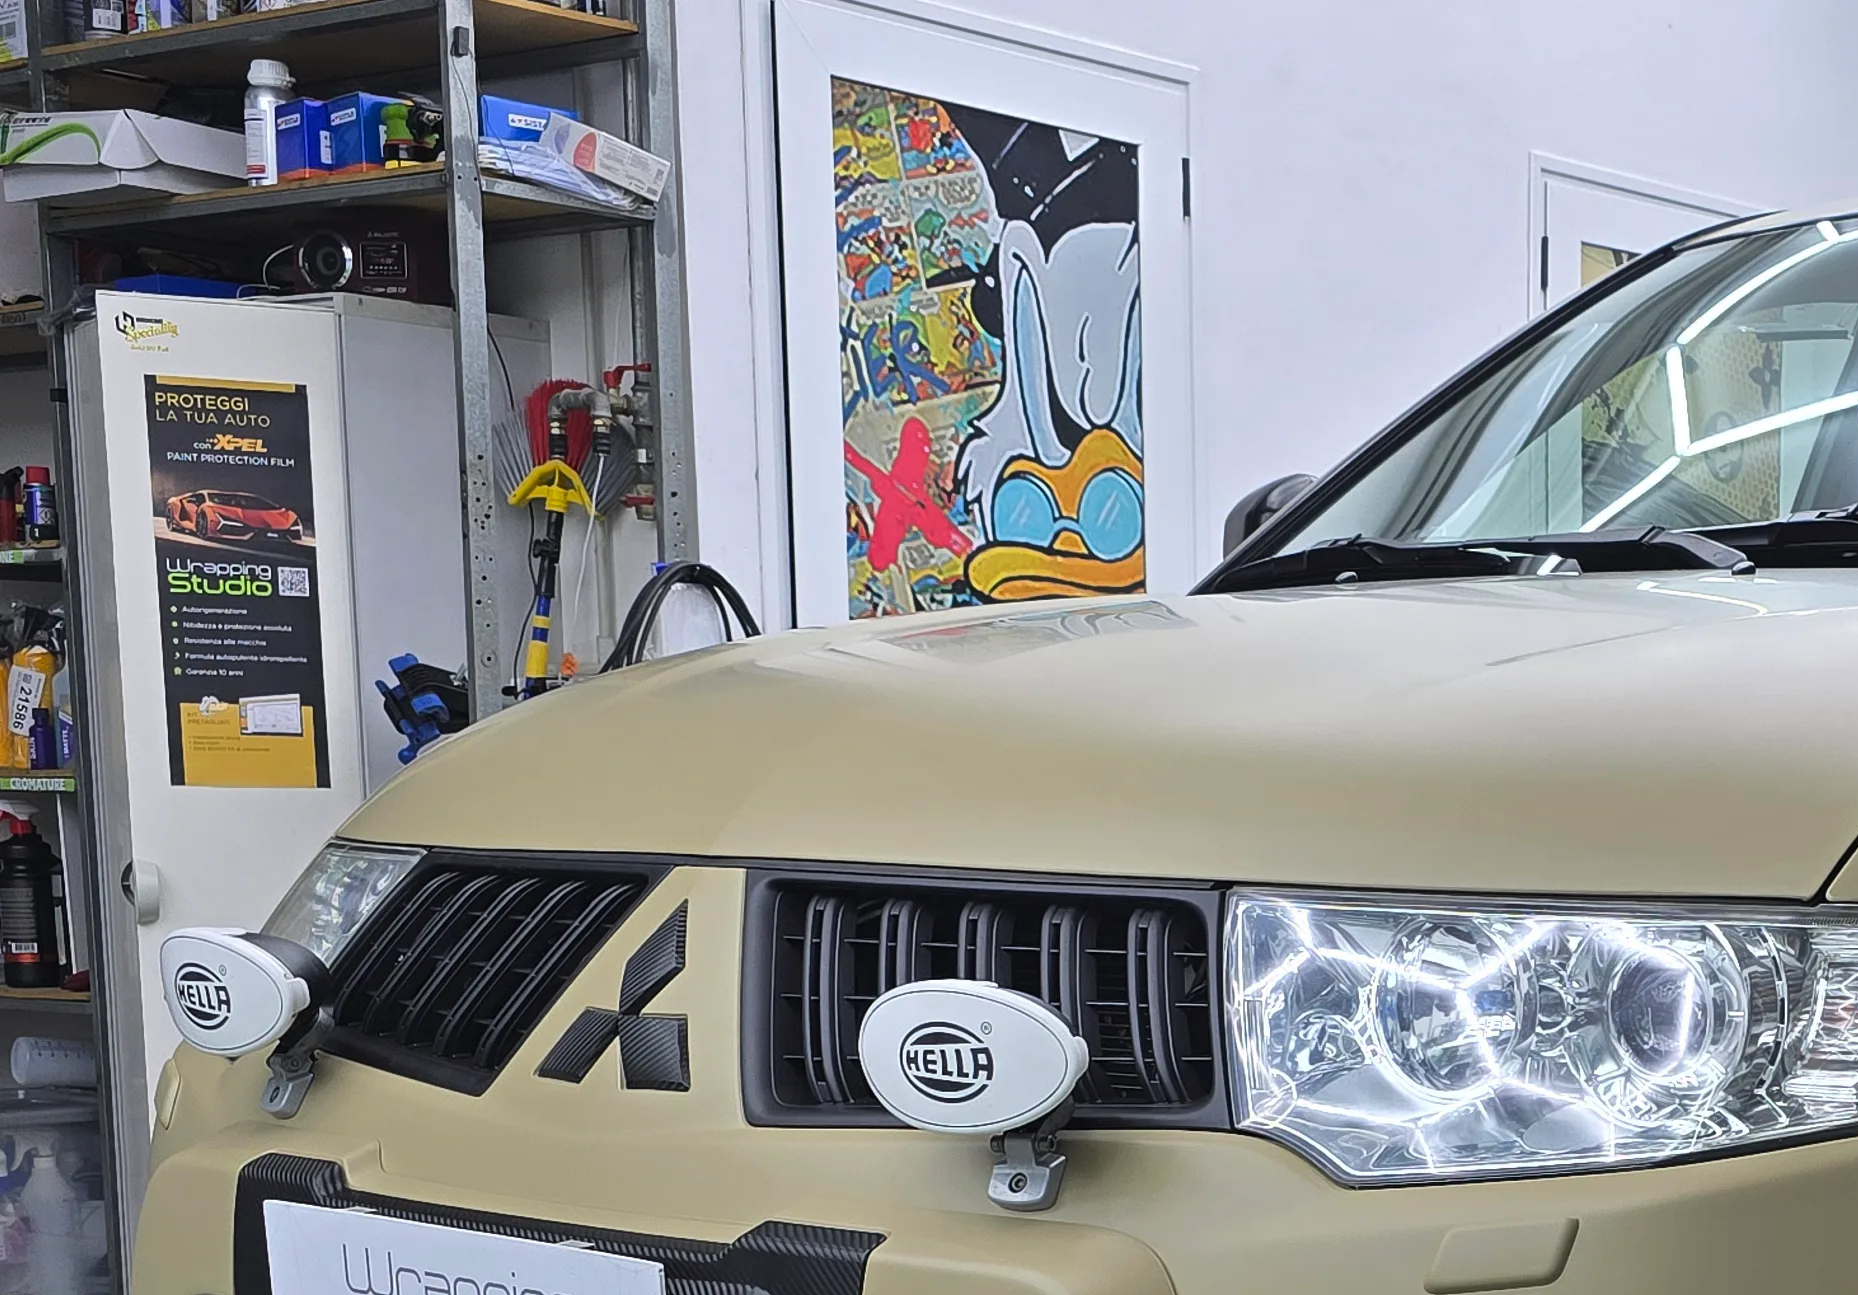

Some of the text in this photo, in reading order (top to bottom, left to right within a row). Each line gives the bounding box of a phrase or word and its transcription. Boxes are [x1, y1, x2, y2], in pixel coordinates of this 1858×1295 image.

[154, 392, 249, 412] PROTEGGI
[155, 409, 271, 428] LA TUA AUTO
[193, 433, 268, 453] con XPEL
[167, 451, 295, 468] PAINT PROTECTION FILM
[166, 557, 272, 581] Wrapping
[167, 572, 273, 597] Studio
[12, 685, 33, 731] 21586
[9, 777, 66, 791] CROMATURE
[177, 983, 232, 1014] HELLA
[905, 1046, 994, 1081] HELLA
